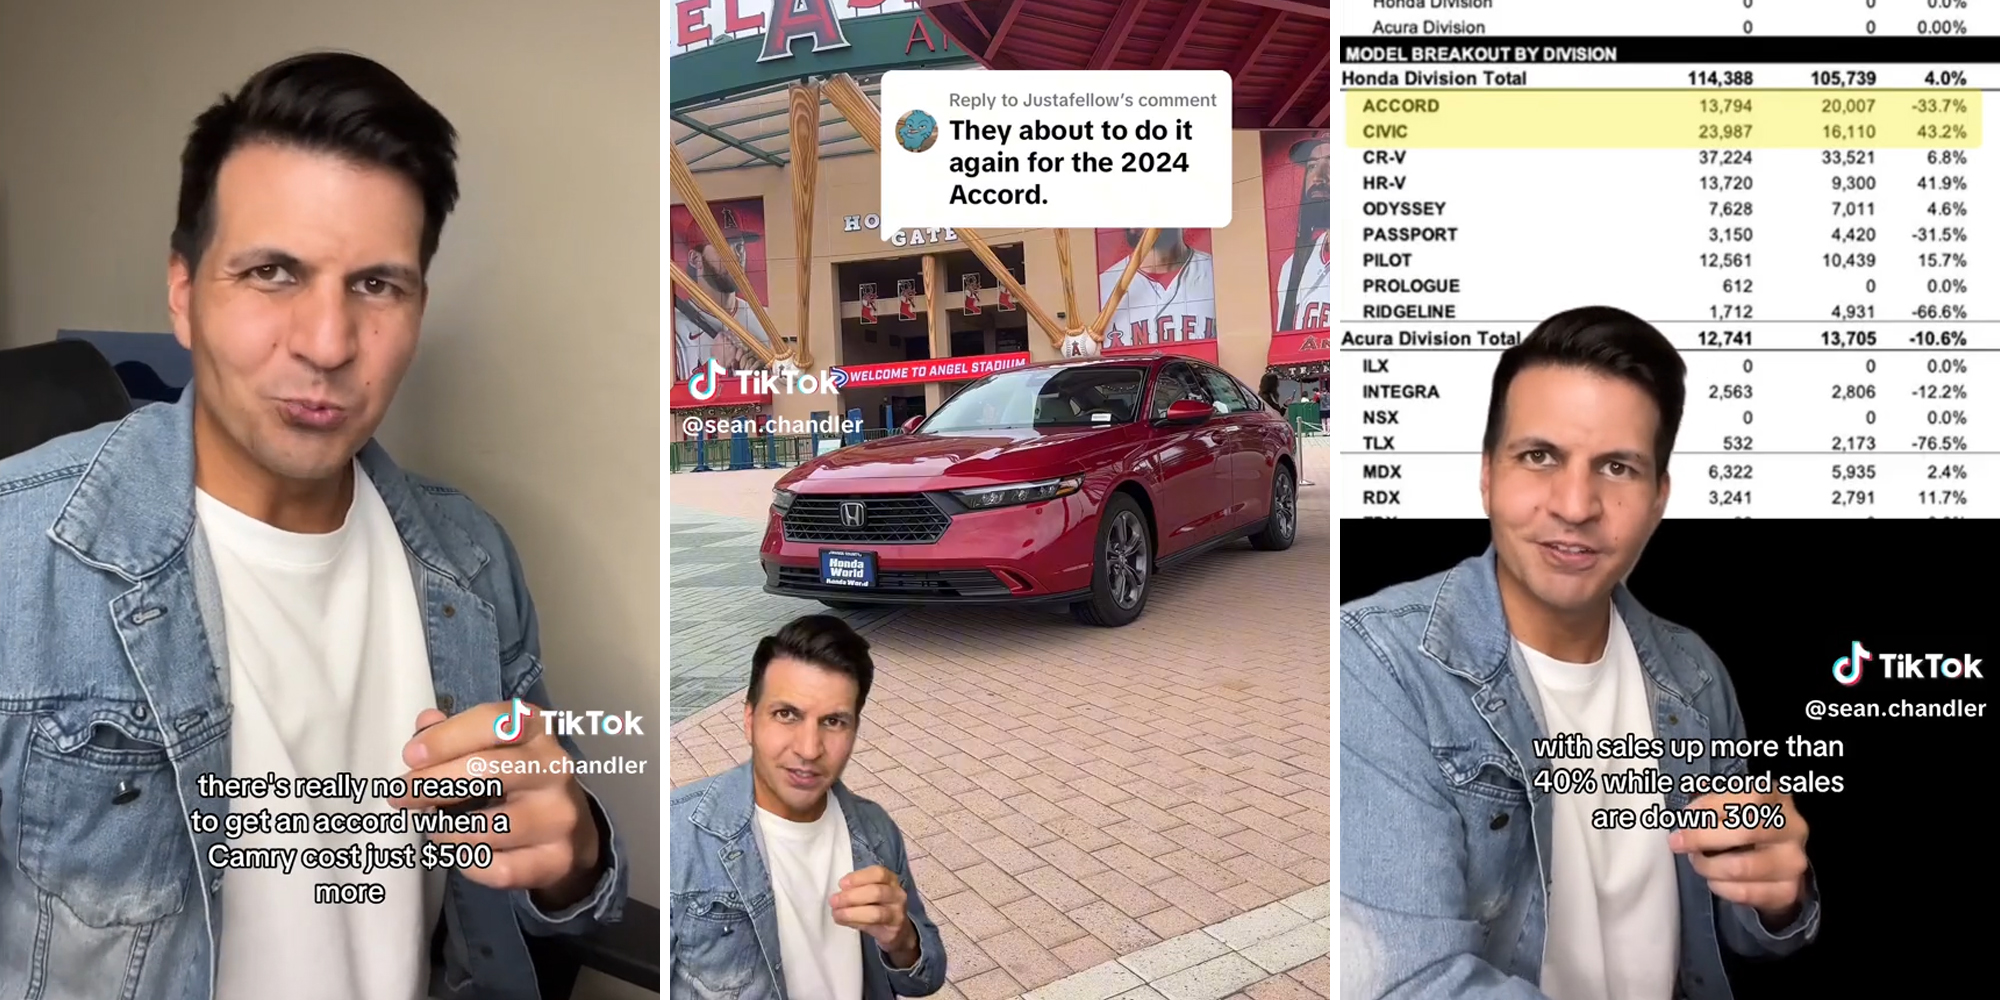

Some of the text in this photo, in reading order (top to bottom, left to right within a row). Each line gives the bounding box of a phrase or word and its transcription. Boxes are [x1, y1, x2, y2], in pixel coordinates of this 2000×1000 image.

[1373, 20, 1966, 34] Acura Division 0 0 0.00%
[1346, 47, 1616, 61] MODEL BREAKOUT BY DIVISION
[1343, 71, 1966, 87] Honda Division Total 114,388 105,739 4.0%
[1363, 99, 1966, 112] ACCORD 13,794 20,007 -33.7%
[1364, 125, 1966, 139] CIVIC 23,987 16,110 43.2%
[1363, 150, 1966, 165] CR-V 37,224 33,521 6.8%
[1364, 176, 1966, 190] HR-V 13,720 9,300 41.9%
[1363, 202, 1966, 216] ODYSSEY 7,628 7,011 4.6%
[891, 226, 958, 247] GATE
[1364, 228, 1966, 242] PASSPORT 3,150 4,420 -31.5%
[1364, 253, 1966, 268] PILOT 12,561 10,439 15.7%
[1364, 279, 1966, 292] PROLOGUE 612 0 0.0%
[1364, 305, 1966, 320] RIDGELINE 1,712 4,931 -66.6%
[1342, 331, 1966, 348] Acura Division Total 12,741 13,705 -10.6%
[850, 367, 908, 383] WELCOME
[911, 366, 927, 377] TO
[929, 363, 968, 376] ANGEL
[1364, 359, 1966, 373] ILX 0 0 0.0%
[1364, 385, 1966, 399] INTEGRA 2,563 2,806 -12.2%
[1364, 411, 1966, 424] NSX 0 0 0.0%
[1363, 437, 1966, 451] TLX 532 2,173 -76.5%
[1364, 465, 1966, 479] MDX 6,322 5,935 2.4%
[1364, 491, 1966, 505] RDX 3,241 2,791 11.7%
[829, 558, 864, 568] Honda
[830, 567, 864, 578] World
